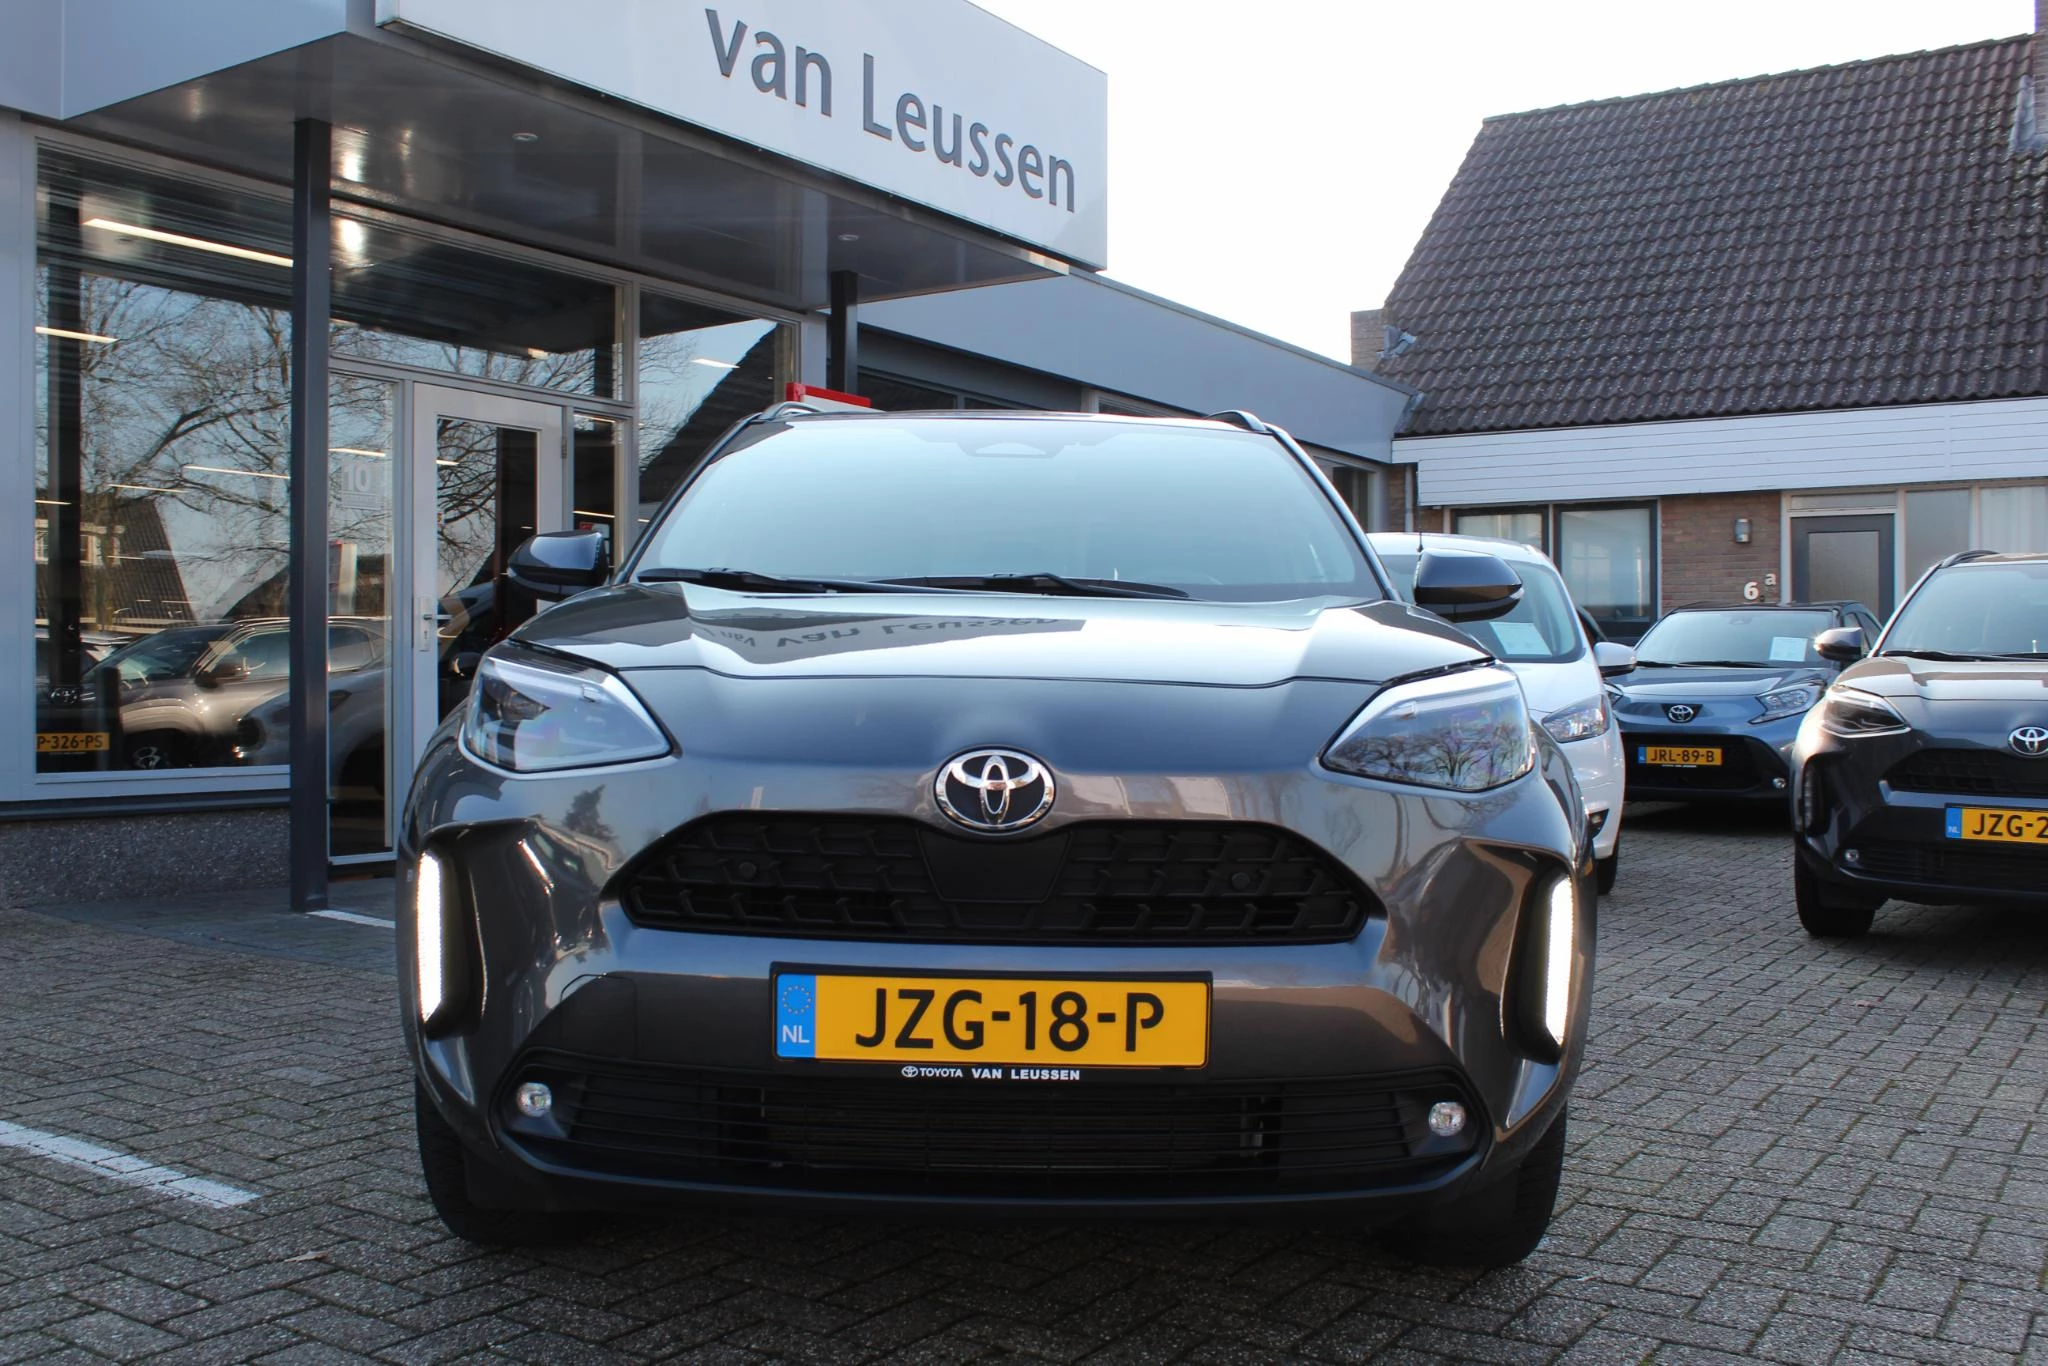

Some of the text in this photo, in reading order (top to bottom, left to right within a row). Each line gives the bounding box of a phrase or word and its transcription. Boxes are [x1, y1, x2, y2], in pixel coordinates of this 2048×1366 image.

[705, 8, 1075, 213] van Leussen
[1650, 749, 1714, 763] JRL-89-B
[1971, 813, 2048, 839] JZG-2
[782, 987, 1165, 1052] NL JZG-18-P
[919, 1067, 1081, 1081] TOYOTA VAN LEUSSEN
